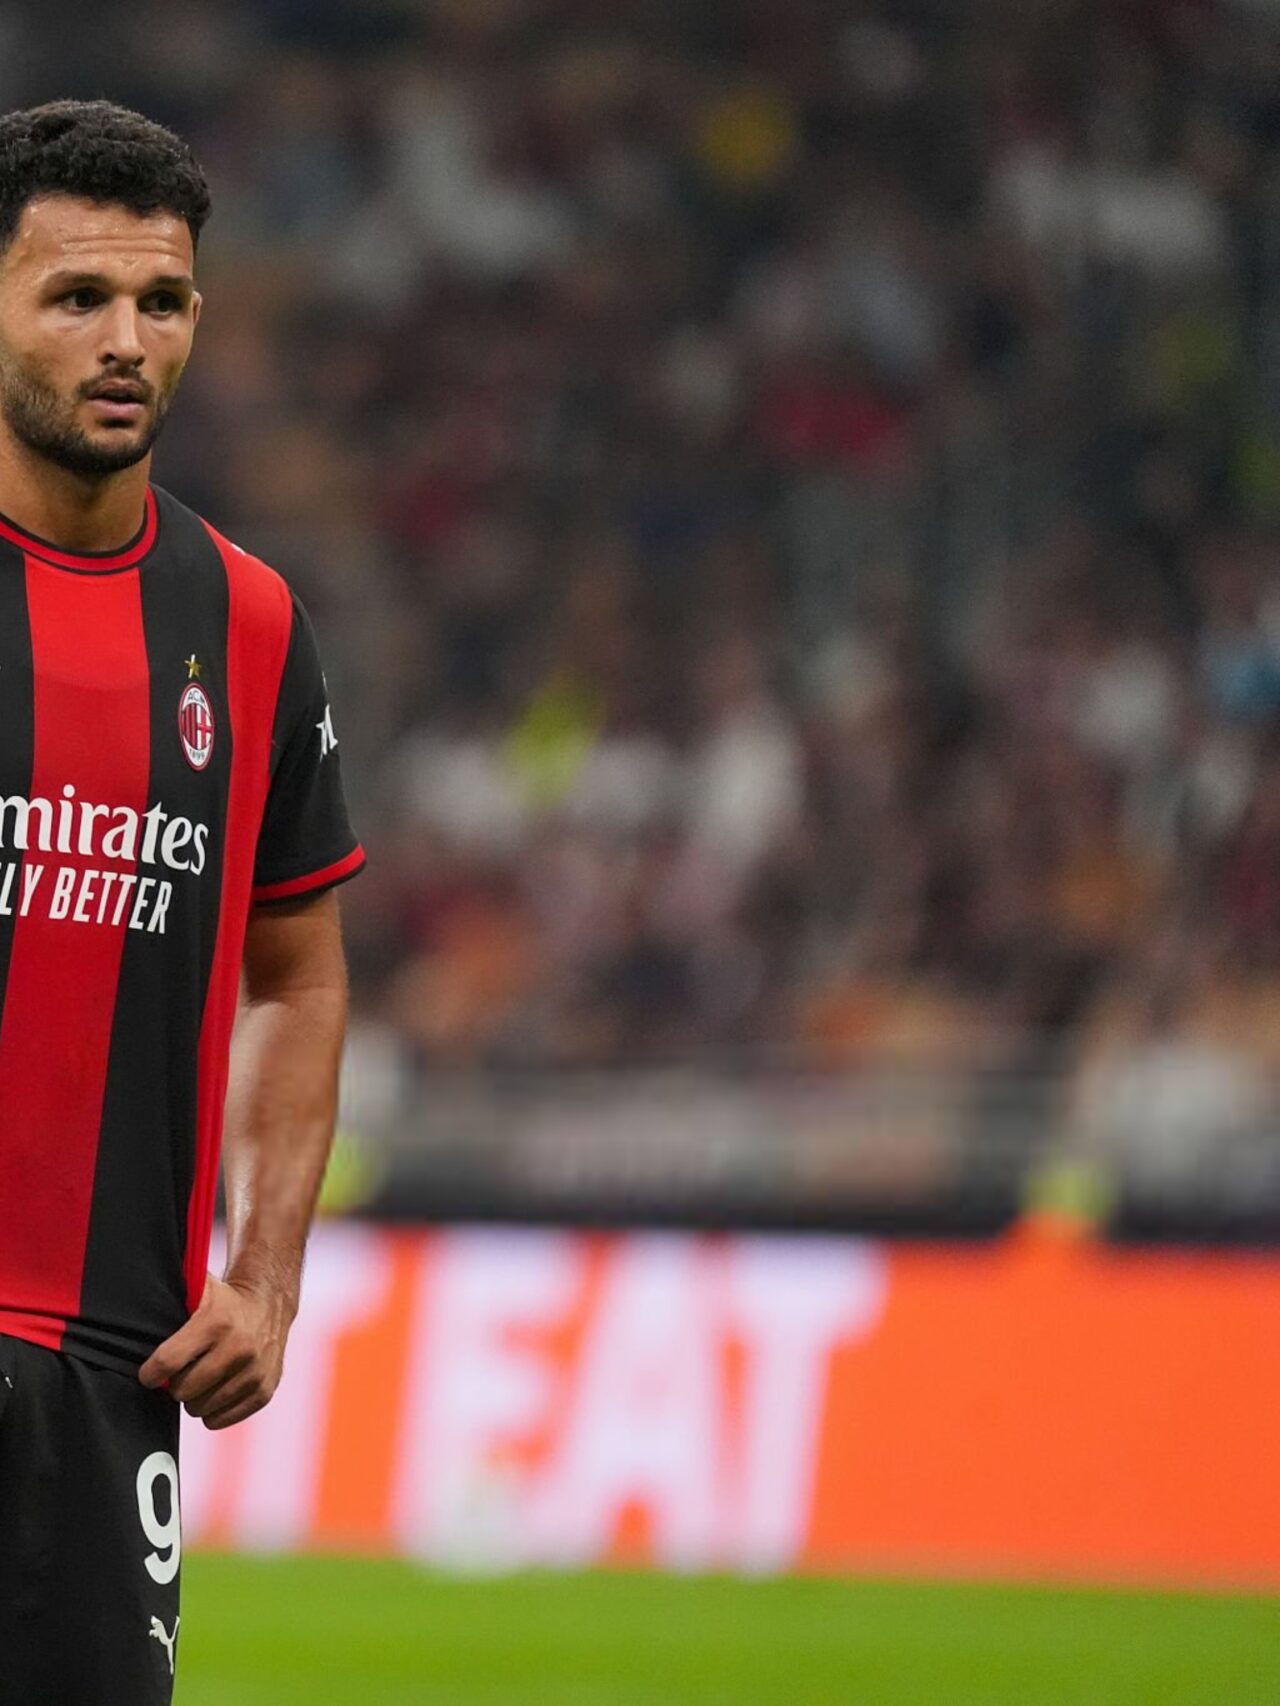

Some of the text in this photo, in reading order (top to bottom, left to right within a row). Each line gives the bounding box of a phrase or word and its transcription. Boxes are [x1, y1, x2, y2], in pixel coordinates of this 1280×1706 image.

[48, 866, 173, 934] BETTER
[398, 1232, 885, 1572] EAT
[136, 1451, 181, 1585] 9
